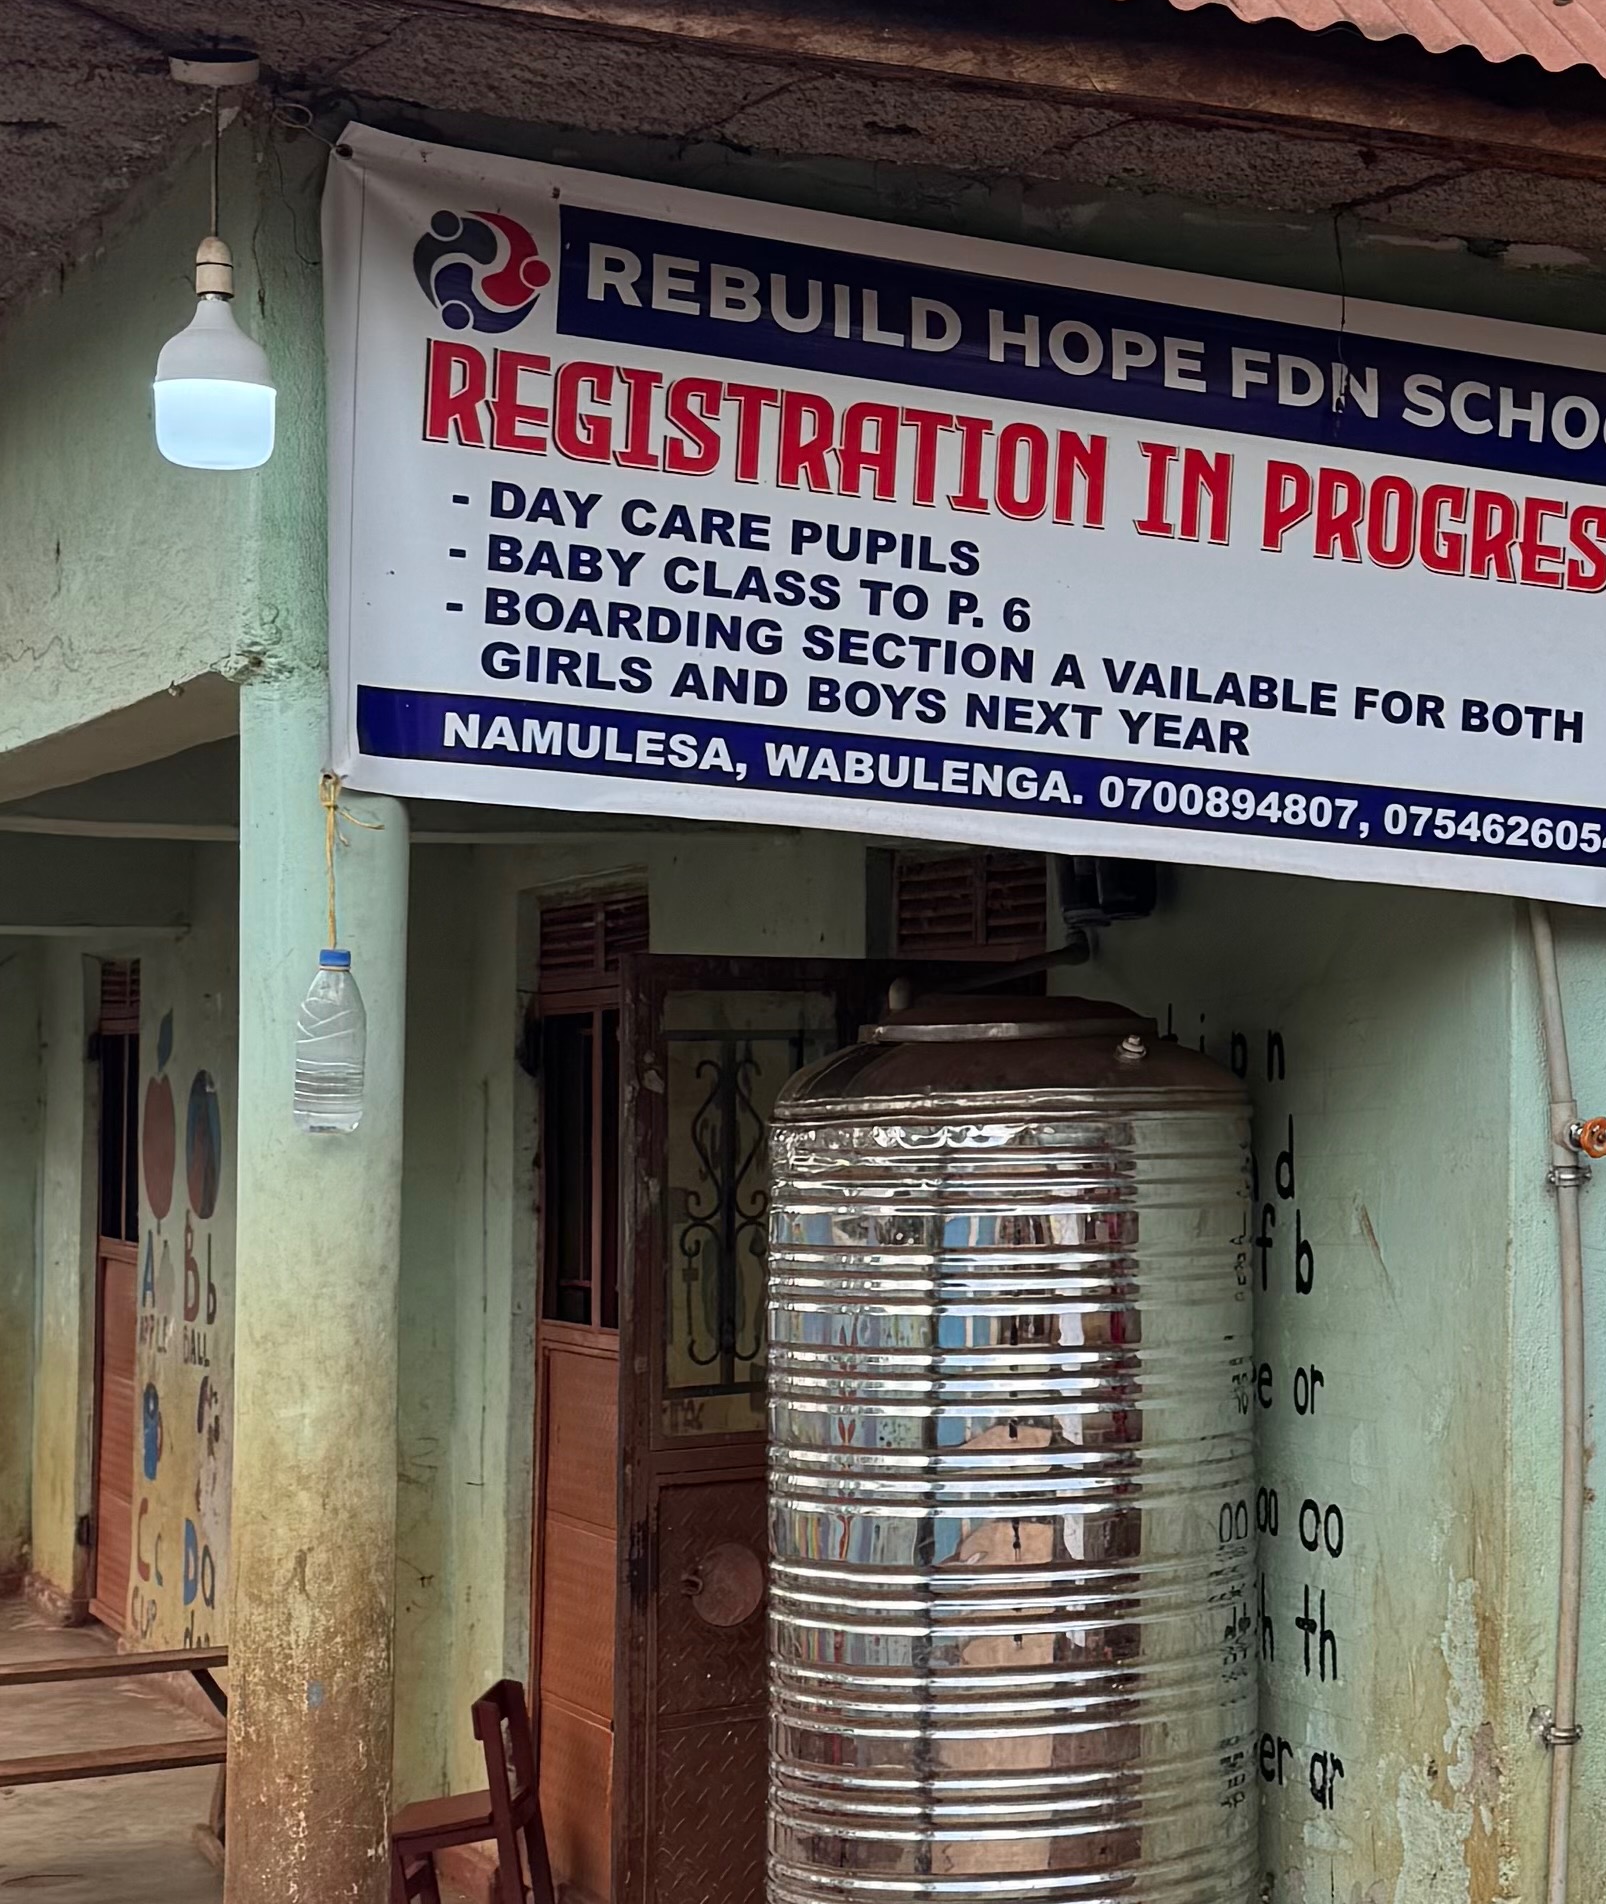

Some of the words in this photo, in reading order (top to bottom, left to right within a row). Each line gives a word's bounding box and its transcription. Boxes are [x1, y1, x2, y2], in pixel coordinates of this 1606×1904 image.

[588, 243, 961, 352] REBUILD
[989, 309, 1206, 392] HOPE
[1232, 347, 1378, 418] FDN
[422, 337, 1109, 528] REGISTRATION
[1133, 440, 1234, 546] IN
[490, 481, 602, 528] DAY
[622, 499, 770, 551] CARE
[791, 520, 979, 576] PUPILS
[488, 534, 645, 587] BABY
[664, 557, 840, 610] CLASS
[860, 579, 928, 620] TO
[948, 590, 983, 627] P.
[1003, 598, 1030, 632] 6
[481, 642, 652, 693] GIRLS
[670, 663, 787, 706] AND
[808, 676, 946, 723] BOYS
[966, 693, 1102, 739] NEXT
[1119, 709, 1249, 756] YEAR
[484, 587, 784, 656] BOARDING
[803, 625, 1033, 683] SECTION
[1355, 687, 1445, 728] FOR
[1462, 699, 1583, 743] BOTH
[444, 712, 746, 780] NAMULESA,
[765, 743, 1082, 804] WABULENGA.
[1100, 776, 1369, 838] 0700894807,
[1276, 1113, 1296, 1200] d
[1256, 1202, 1276, 1292] f
[1295, 1208, 1315, 1296] b
[1293, 1363, 1325, 1416] or
[1295, 1583, 1338, 1683] th
[1258, 1731, 1294, 1786] er
[1309, 1748, 1345, 1811] ar
